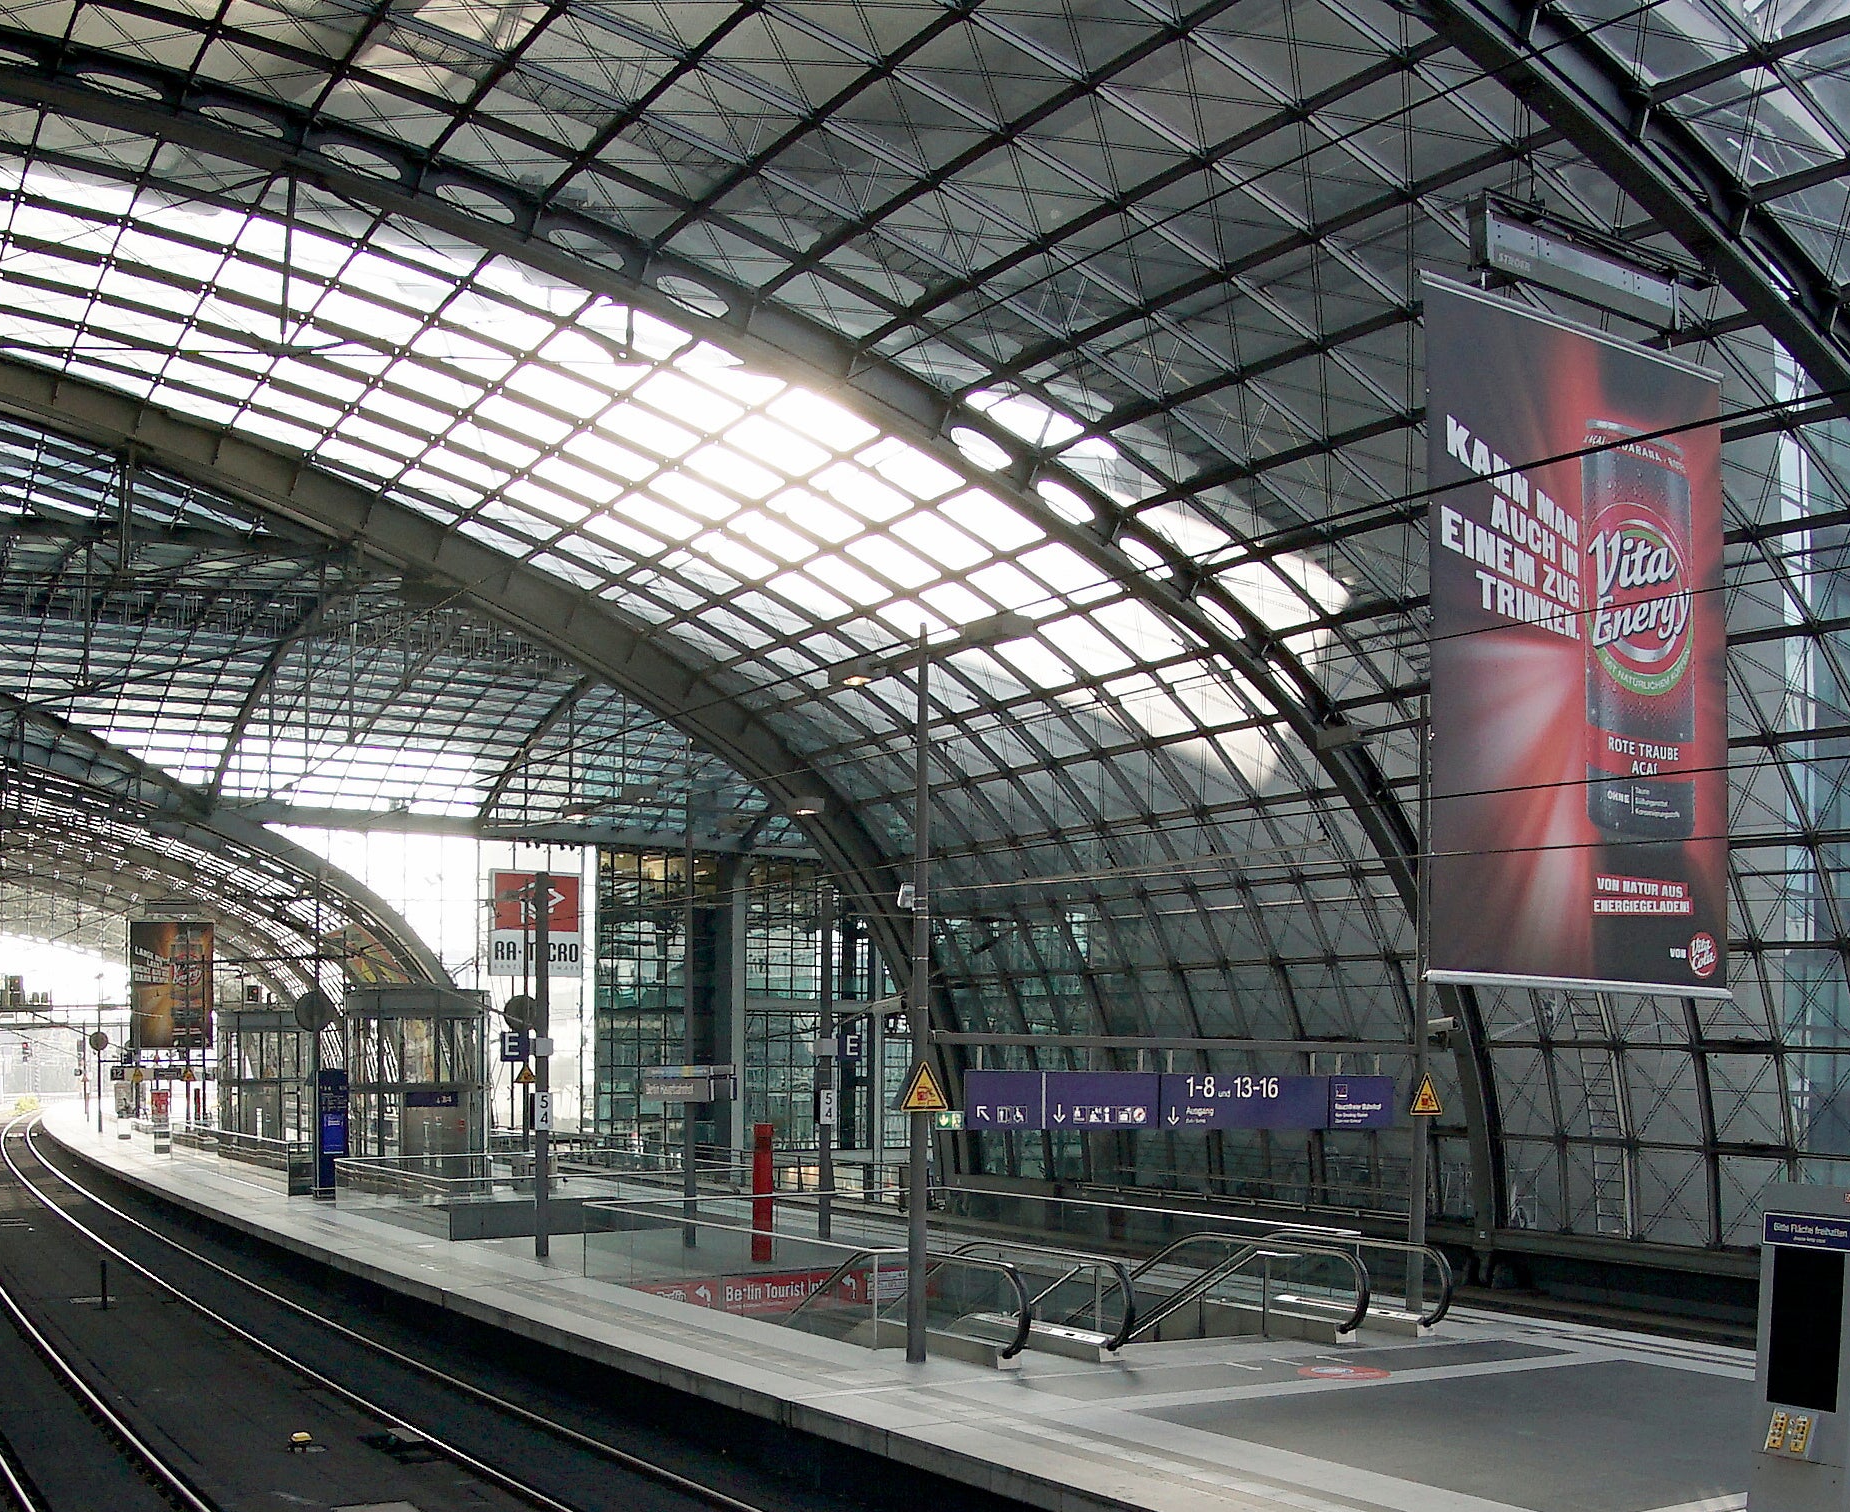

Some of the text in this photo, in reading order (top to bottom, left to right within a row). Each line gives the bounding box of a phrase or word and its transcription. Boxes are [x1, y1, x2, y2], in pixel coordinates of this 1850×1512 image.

[1447, 414, 1578, 547] KANN MAN
[1491, 494, 1579, 577] AUCH IN
[1441, 505, 1579, 609] EINEM ZUG
[1588, 530, 1676, 596] Vita
[1475, 569, 1580, 640] TRINKEN.
[1593, 588, 1690, 648] Energy
[1608, 736, 1679, 761] ROTE TRAUBE
[1607, 790, 1630, 804] OHNE
[1596, 877, 1683, 898] VON NATUR AUS
[1593, 899, 1690, 913] ENERGIEGELADEN!
[1669, 947, 1686, 959] VON
[504, 1032, 519, 1056] E
[846, 1034, 859, 1056] E
[1186, 1076, 1215, 1098] 1-8
[1233, 1076, 1279, 1099] 13-16
[540, 1095, 549, 1109] 5
[825, 1093, 833, 1105] 5
[540, 1111, 549, 1125] 4
[825, 1107, 833, 1119] 4
[765, 1281, 805, 1299] Tourist
